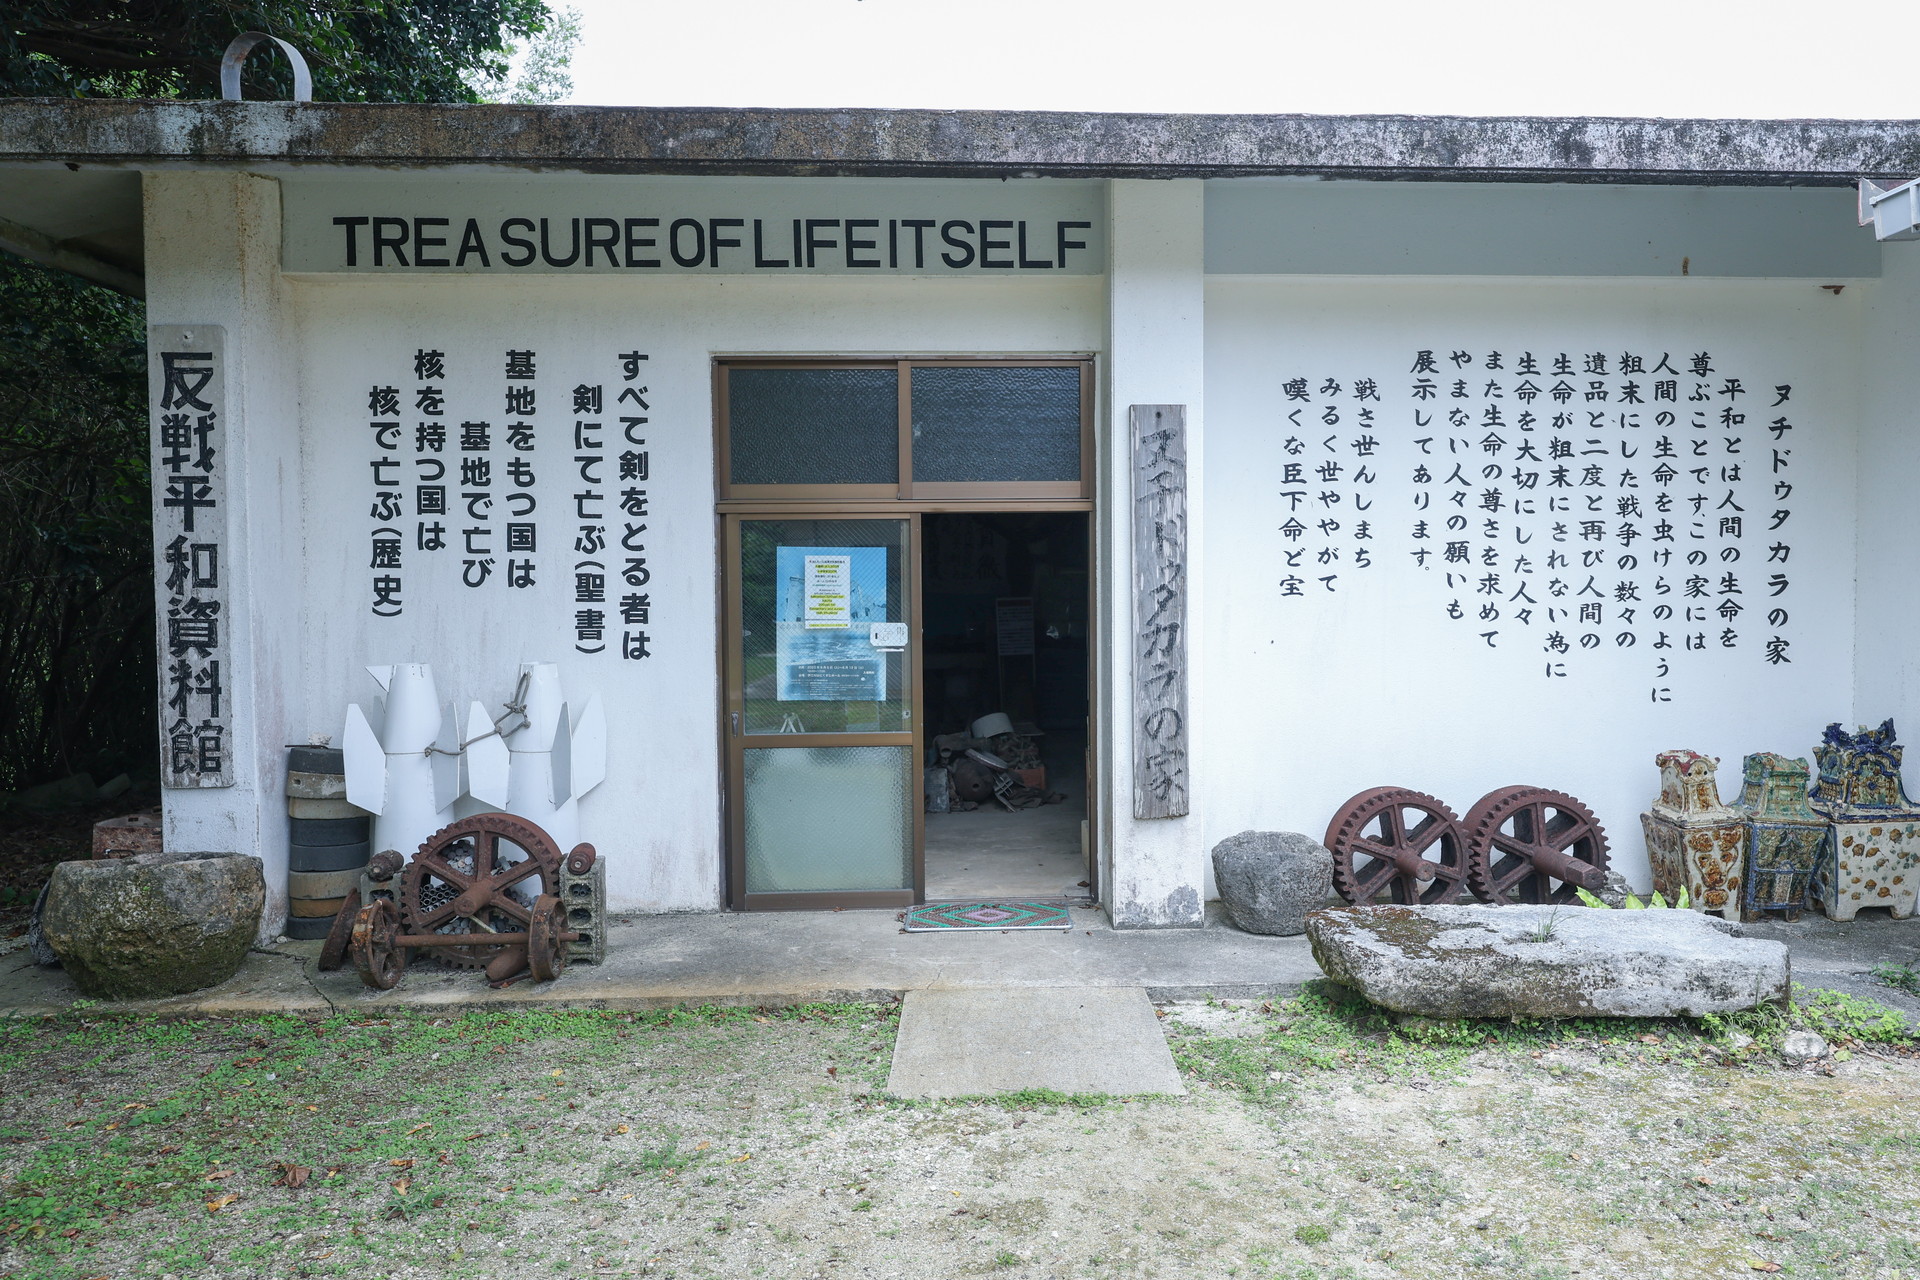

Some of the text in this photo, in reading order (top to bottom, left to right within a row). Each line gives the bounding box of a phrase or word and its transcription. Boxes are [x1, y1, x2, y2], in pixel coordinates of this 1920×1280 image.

[160, 351, 223, 776] 反戦平和資料館
[414, 349, 446, 551] 核を持つ国は
[460, 421, 495, 587] 基地で亡び
[505, 350, 536, 588] 基地をもつ国は
[617, 351, 651, 660] すべて剣をとる者は
[1279, 378, 1311, 596] 嘆くな臣下命ど宝
[1315, 378, 1343, 592] みるく世ややがて
[1351, 378, 1380, 568] 戦さ世んしまち
[1410, 350, 1439, 570] 展示してあります。
[1443, 350, 1472, 619] やまない人々の願いも
[1477, 351, 1507, 647] また生命の尊さを求めて
[1509, 352, 1542, 625] 生命を大切にした人々
[1544, 353, 1576, 677] 生命が粗末にされない為に
[1577, 352, 1610, 649] 遺品と二度と再び人間の
[1614, 351, 1646, 647] 粗末にした戦争の数々の
[1651, 352, 1680, 702] 人間の生命を虫けらのように
[1716, 379, 1745, 647] 平和とは人間の生命を
